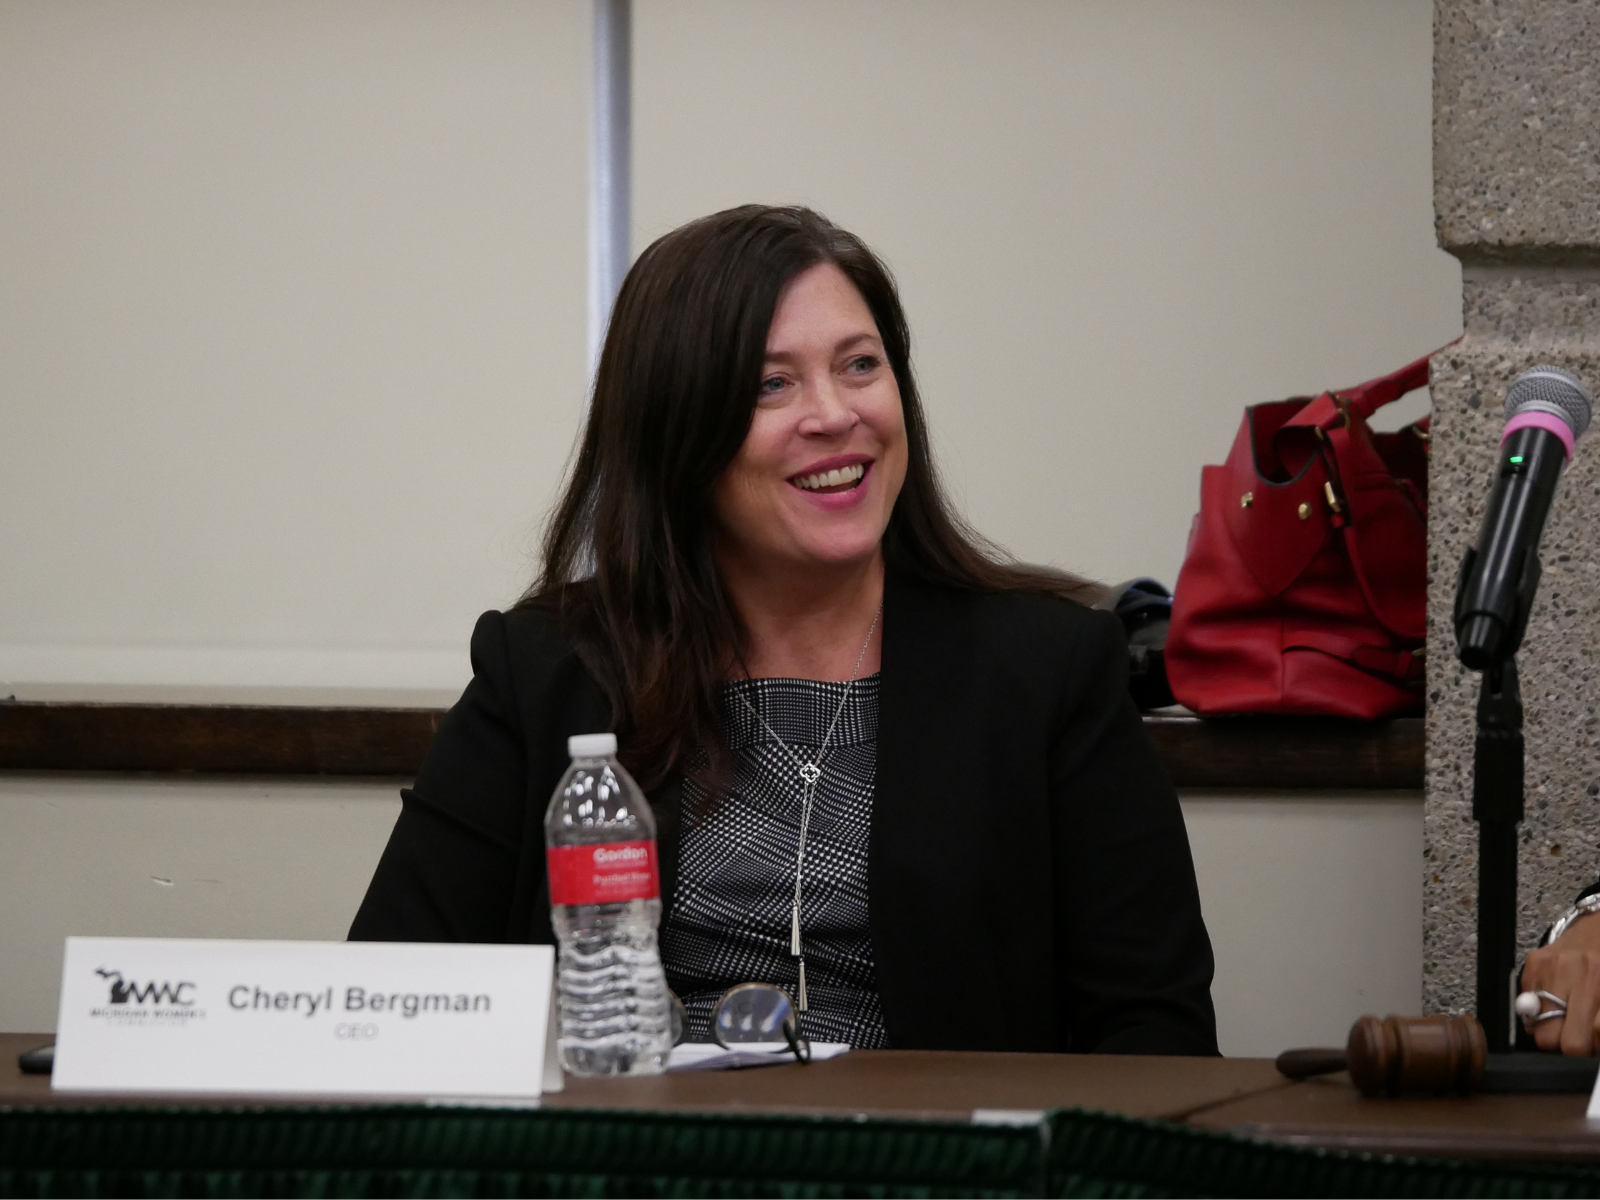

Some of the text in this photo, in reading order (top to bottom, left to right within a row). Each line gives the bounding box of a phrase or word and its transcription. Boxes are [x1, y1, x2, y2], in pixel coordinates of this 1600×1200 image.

[593, 845, 648, 862] Gordon
[228, 984, 492, 1019] Cheryl Bergman
[333, 1022, 379, 1041] CEO
